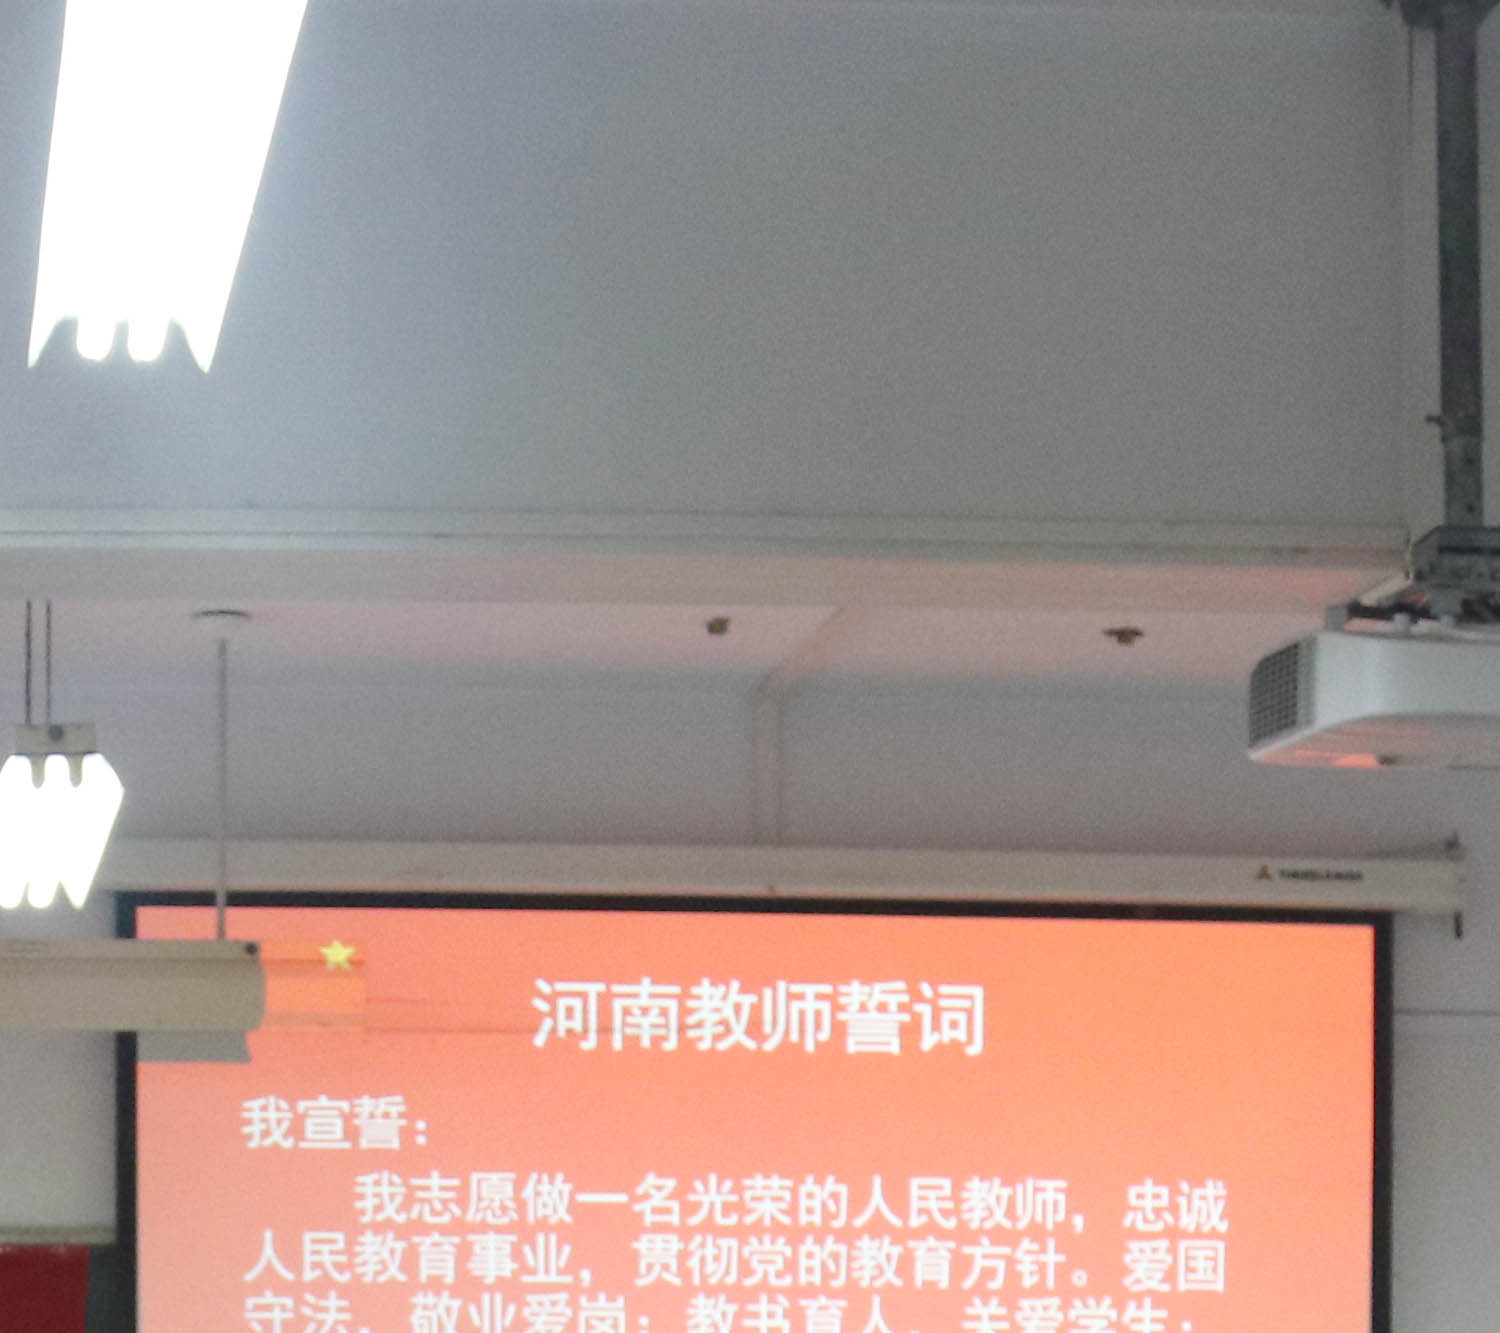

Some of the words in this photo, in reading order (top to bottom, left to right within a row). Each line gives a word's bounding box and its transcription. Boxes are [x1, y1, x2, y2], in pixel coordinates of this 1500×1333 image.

[531, 976, 986, 1056] 河南教师誓词
[241, 1095, 429, 1149] 我宣誓：
[353, 1171, 1229, 1234] 我志愿做一名光荣的人民教师，忠诚
[243, 1229, 1227, 1293] 人民教育事业，贯彻党的教育方针。爱国
